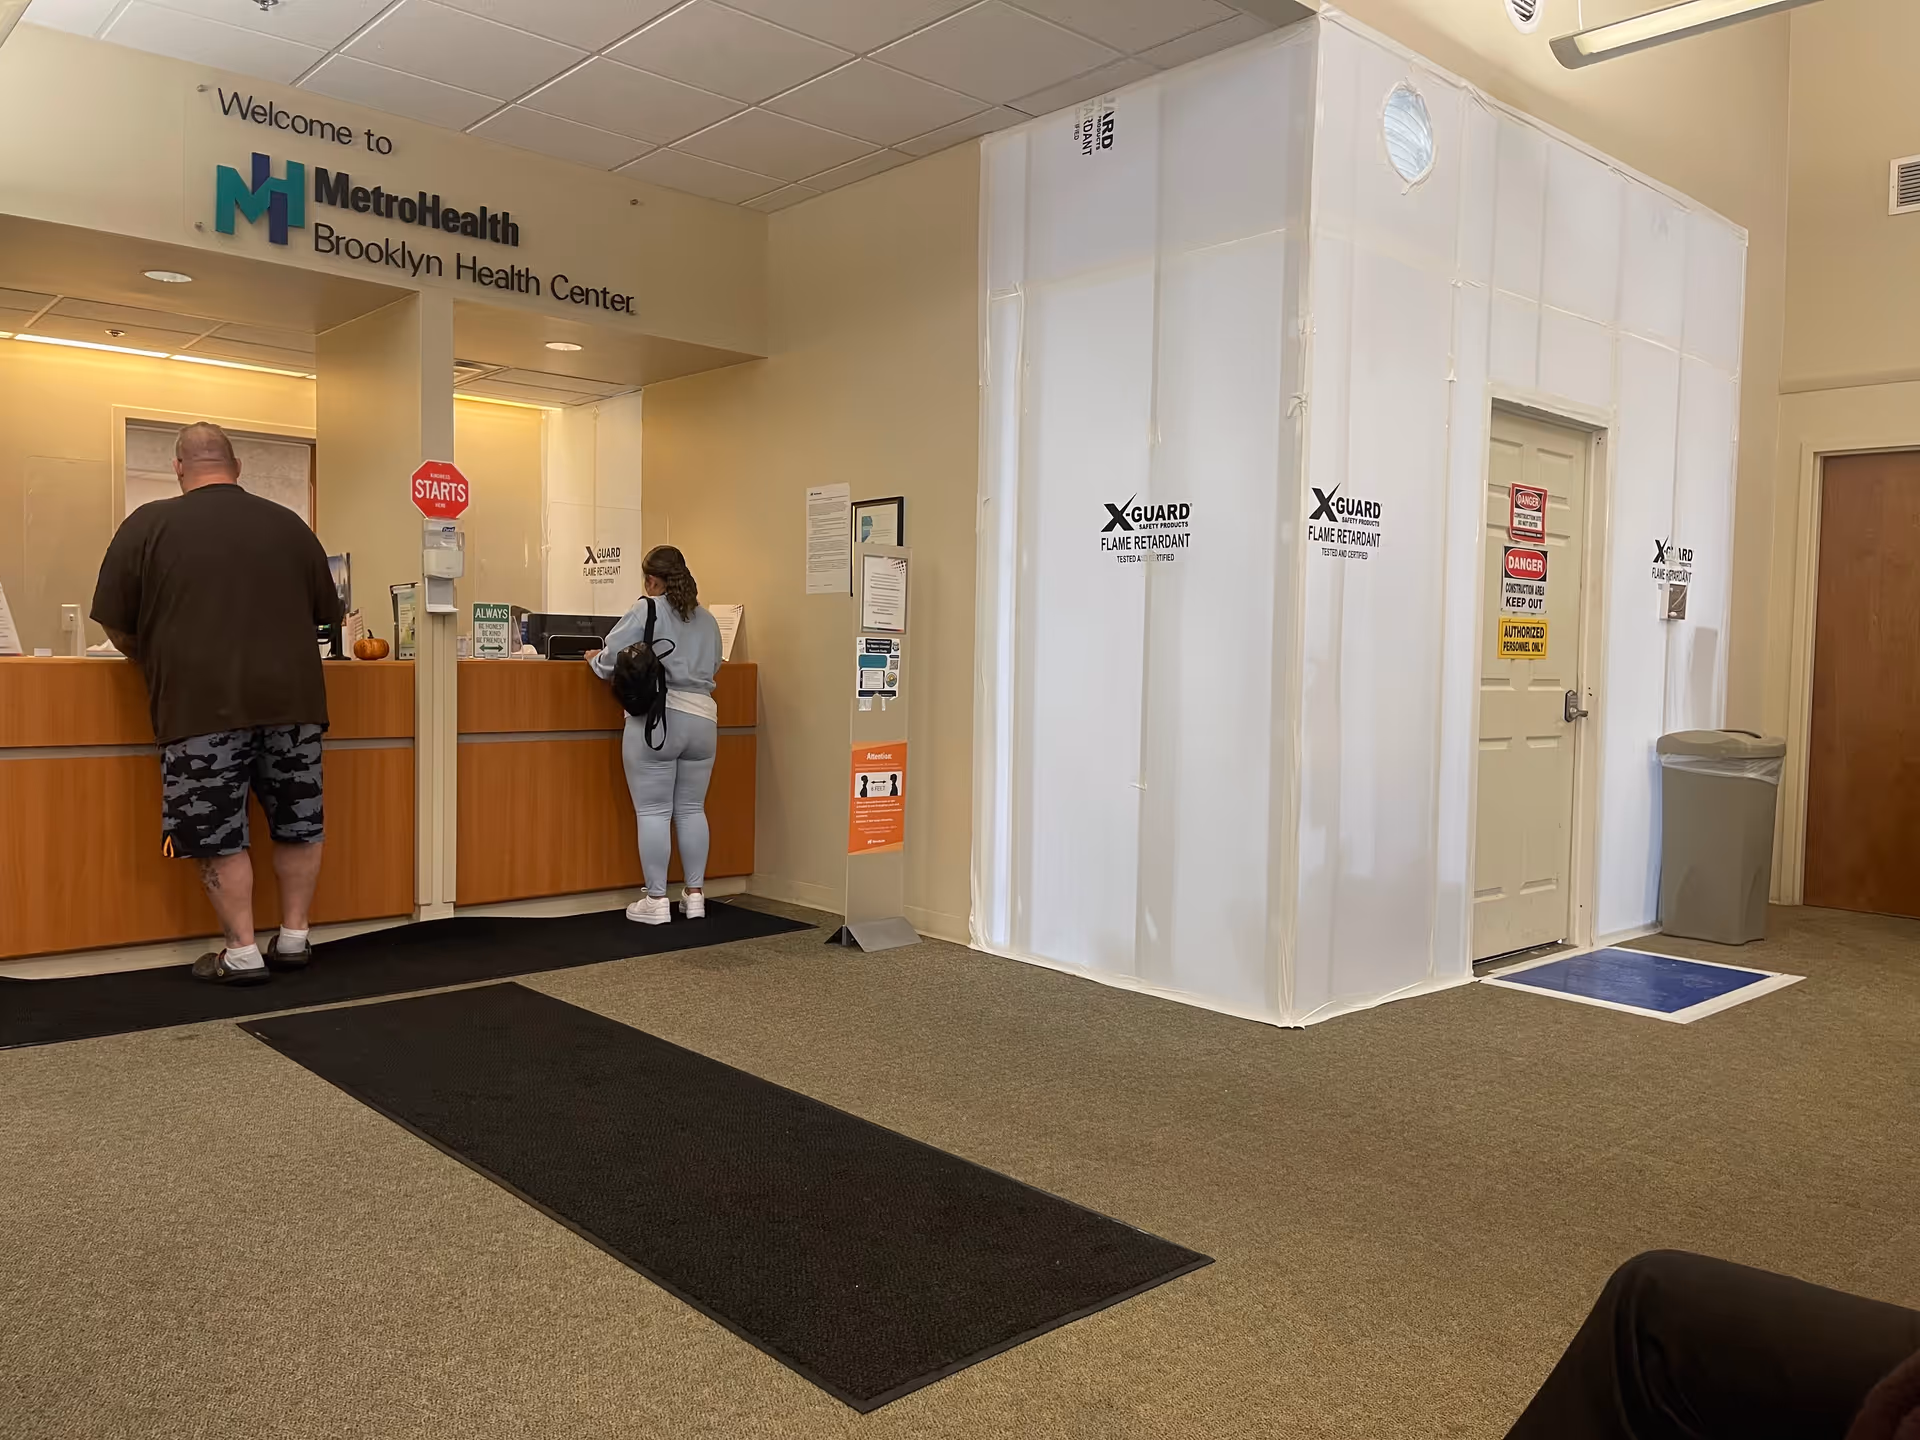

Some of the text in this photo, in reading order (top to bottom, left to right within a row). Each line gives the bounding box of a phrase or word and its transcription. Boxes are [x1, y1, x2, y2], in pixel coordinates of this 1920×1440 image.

[217, 87, 393, 155] Welcome to
[314, 167, 519, 247] MetroHealth
[314, 223, 635, 314] Brooklyn Health Center
[415, 479, 466, 502] STARTS
[1309, 482, 1381, 523] X-GUARD
[1518, 495, 1539, 507] DANGER
[1101, 492, 1190, 533] X-GUARD
[1160, 521, 1189, 529] PRODUCTS
[1342, 517, 1380, 527] SAFETY PRODUCTS
[1101, 533, 1191, 551] FLAME RETARDANT
[1308, 525, 1381, 548] FLAME RETARDANT
[1117, 555, 1136, 563] TESTED
[1322, 547, 1338, 557] TESTED
[1508, 555, 1544, 573] DANGER
[583, 567, 597, 577] FLAME
[1505, 582, 1545, 596] CONSTRUCTION AREA
[1505, 596, 1543, 609] KEEP OUT
[475, 607, 508, 619] ALWAYS
[1504, 625, 1545, 639] AUTHORIZED
[1503, 641, 1544, 653] PERSONNEL ONLY
